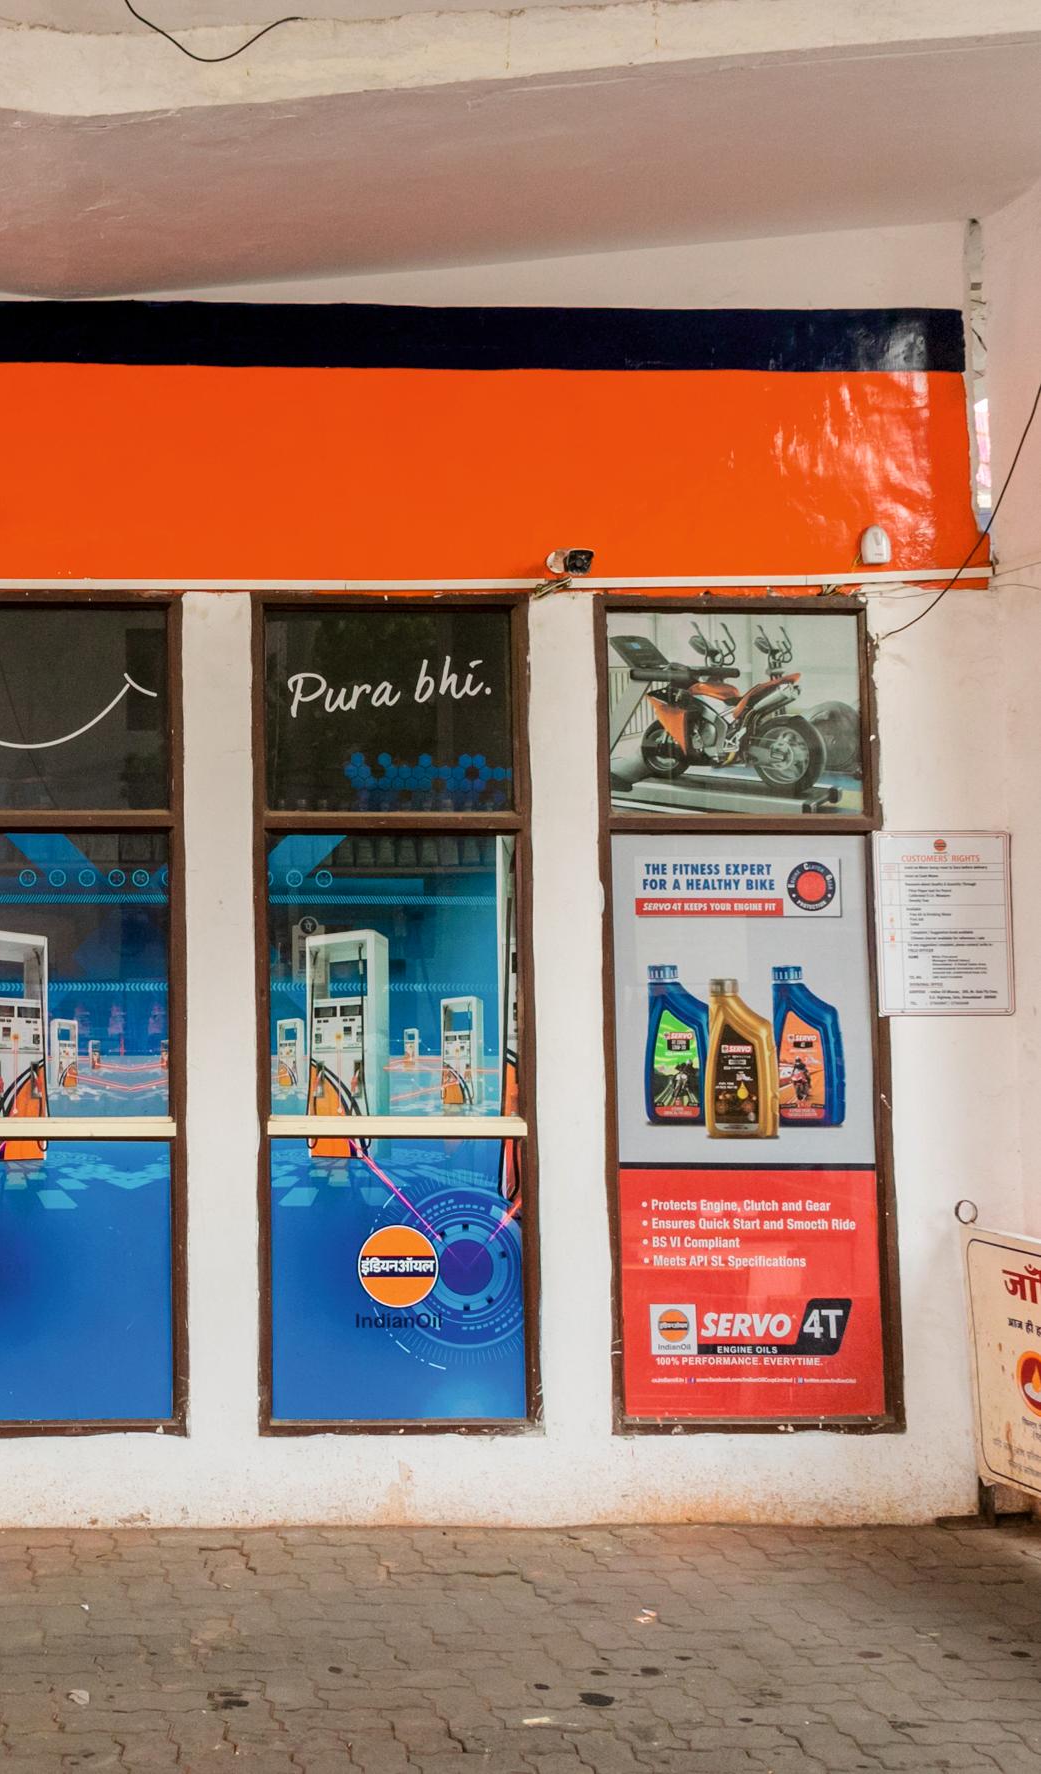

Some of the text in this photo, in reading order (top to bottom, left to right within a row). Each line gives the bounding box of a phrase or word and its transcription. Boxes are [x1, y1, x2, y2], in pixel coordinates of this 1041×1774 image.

[287, 655, 492, 718] Pura bhi.
[901, 854, 980, 863] CUSTOMERS RIGHTS
[645, 864, 772, 875] THE FITNESS EXPERT
[643, 879, 775, 890] FOR A HEALTHY BIKE
[642, 902, 776, 911] SERVO 4T KEEPS YOUR ENGINE FIT
[651, 1200, 831, 1213] Protects Engine, Clutch and Gear
[652, 1218, 856, 1231] Ensures Quick Start and Smooth Ride
[652, 1237, 740, 1249] BS VI Compliant
[653, 1255, 807, 1268] Meets API SL Specifications
[355, 1312, 442, 1328] IndianOil
[701, 1309, 844, 1339] SERVO 4T
[658, 1343, 691, 1351] IndianOil
[656, 1357, 823, 1366] 100% PERFORMANCE. EVERYTIME.
